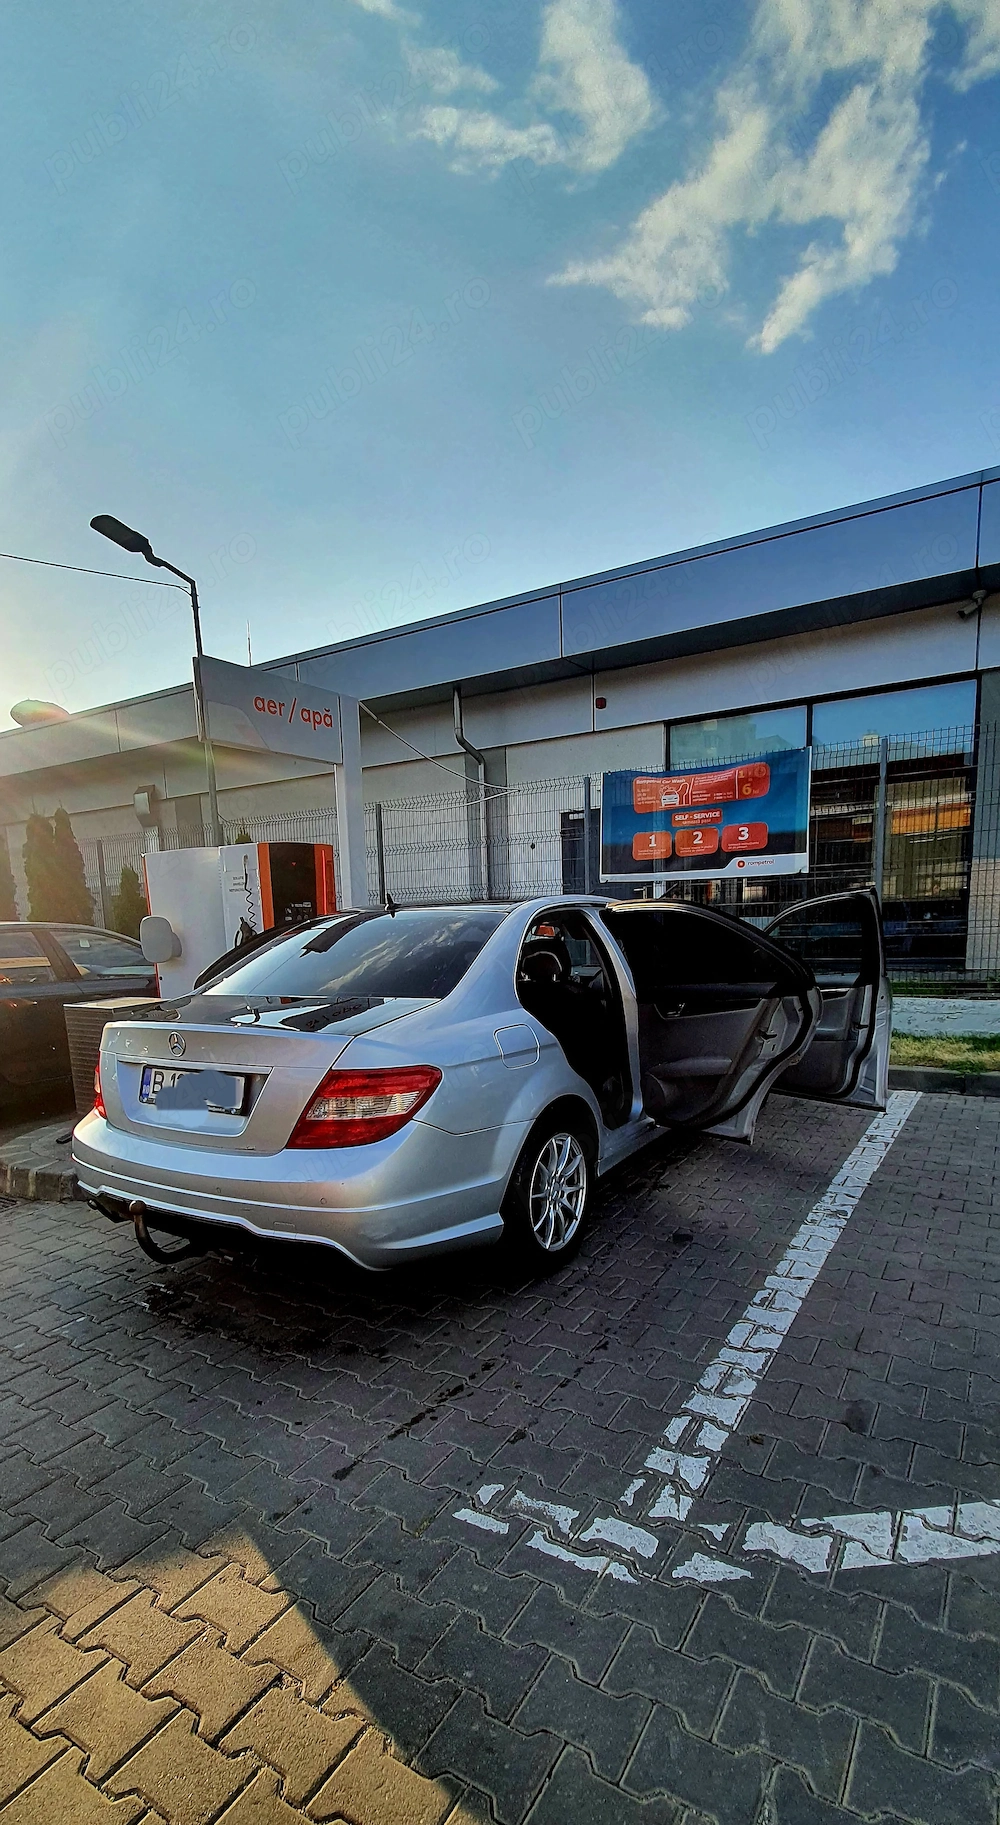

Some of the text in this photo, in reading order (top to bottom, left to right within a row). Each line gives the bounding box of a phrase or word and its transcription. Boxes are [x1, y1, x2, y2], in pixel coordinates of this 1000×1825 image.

[253, 695, 333, 730] aer / apă
[742, 783, 752, 795] 6
[675, 813, 689, 821] SELF
[693, 811, 720, 820] SERVICE
[648, 834, 657, 848] 1
[692, 830, 703, 845] 2
[737, 826, 749, 841] 3
[152, 1070, 165, 1094] B
